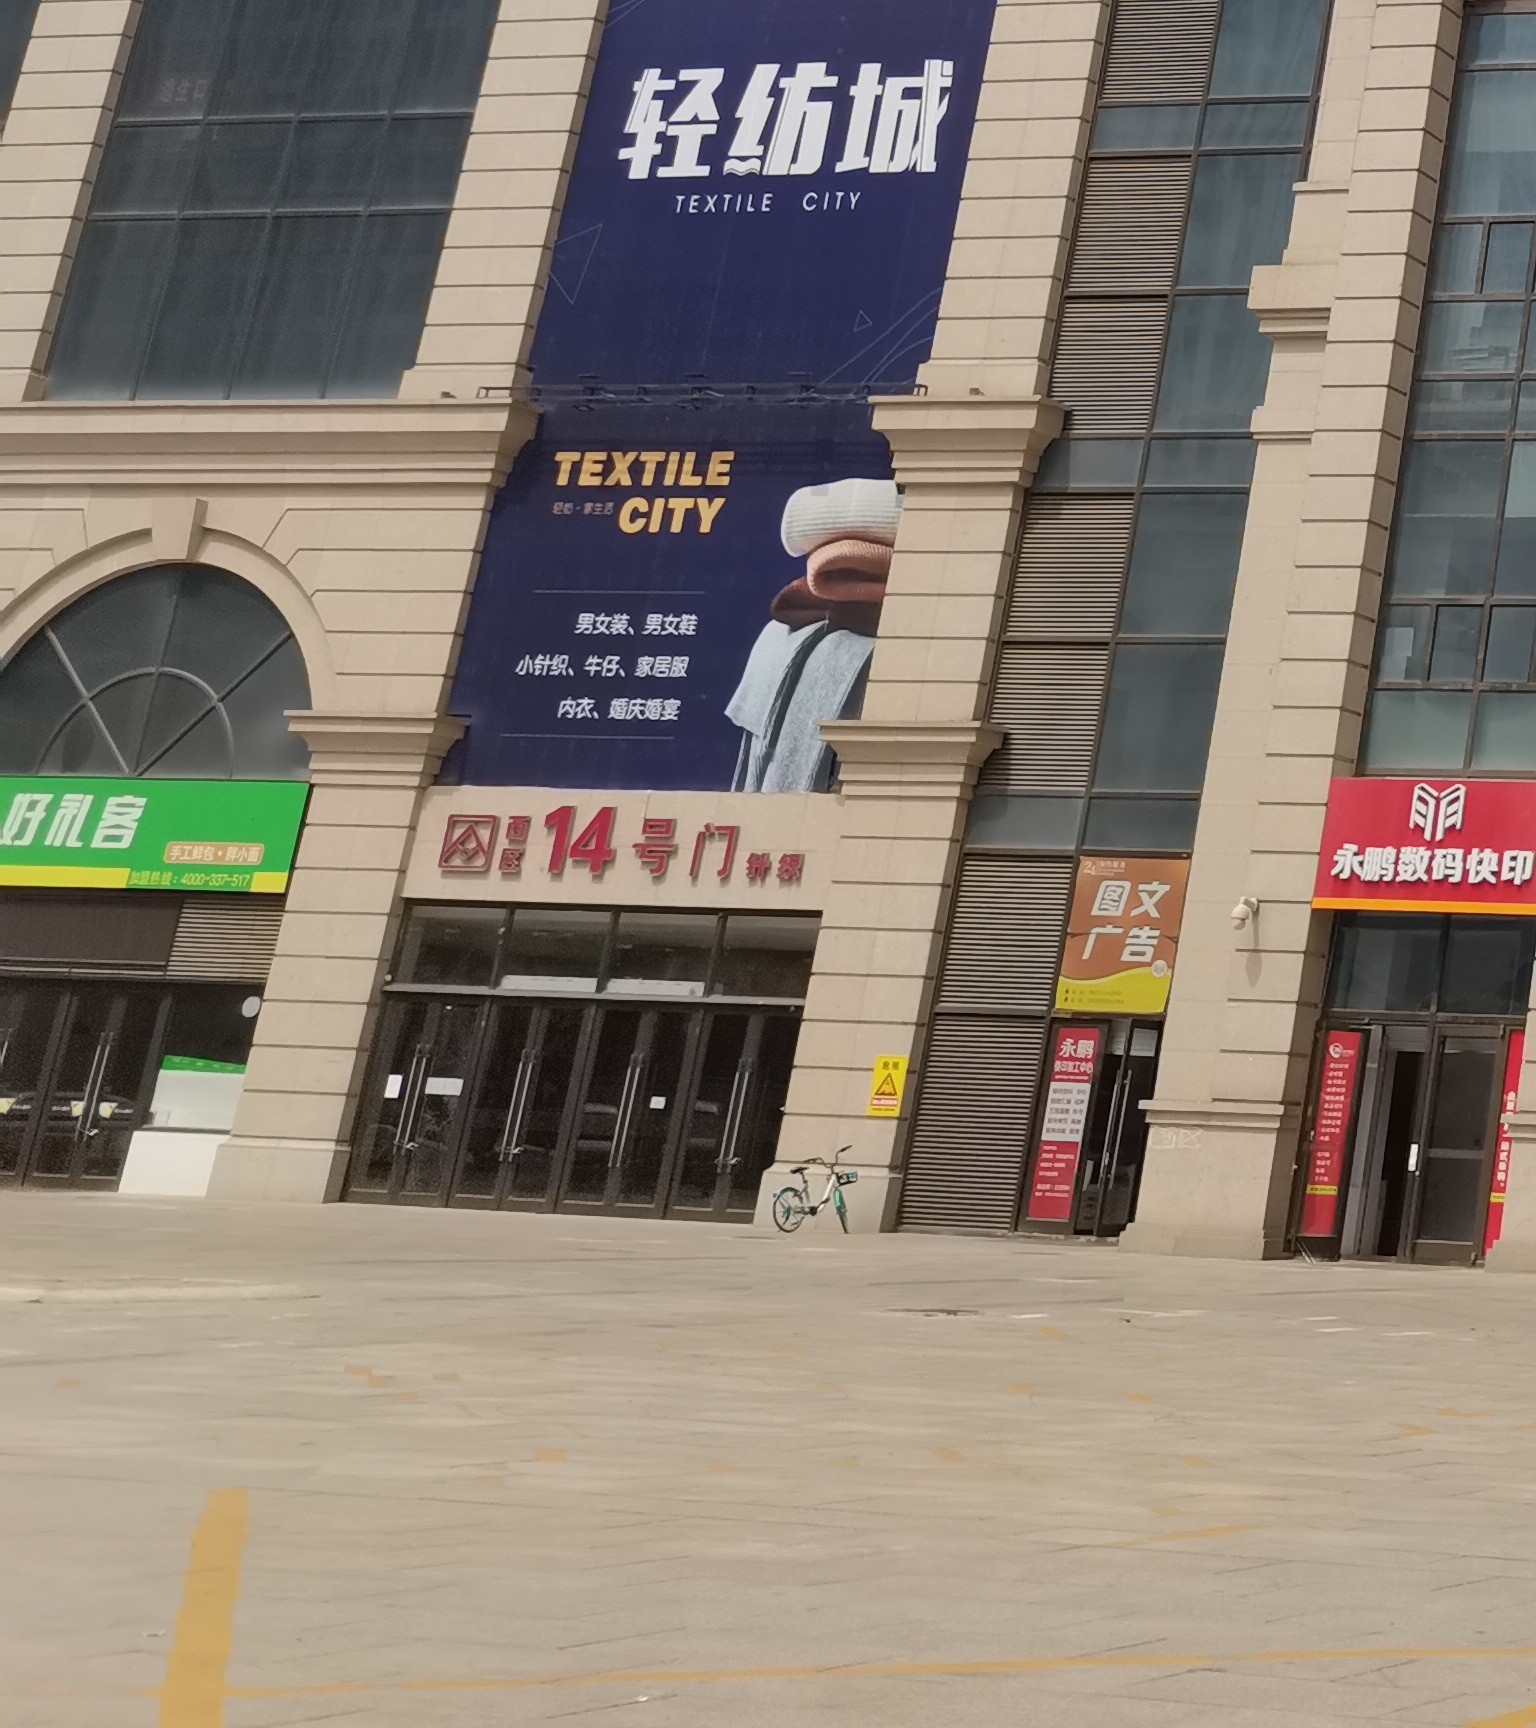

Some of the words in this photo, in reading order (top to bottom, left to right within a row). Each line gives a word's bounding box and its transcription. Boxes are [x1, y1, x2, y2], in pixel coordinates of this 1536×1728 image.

[618, 58, 954, 180] 轻纺城
[674, 193, 774, 215] TEXTILE
[802, 190, 864, 213] CITY
[554, 451, 735, 487] TEXTILE
[619, 496, 726, 534] CITY
[574, 612, 698, 637] 男女装、男女鞋
[515, 654, 689, 679] 小针织、牛仔、家居服
[544, 806, 741, 879] 14号门
[746, 852, 806, 881] 针织
[1330, 843, 1536, 886] 永鹏数码快印
[1090, 880, 1172, 918] 图文
[1081, 924, 1161, 963] 广告
